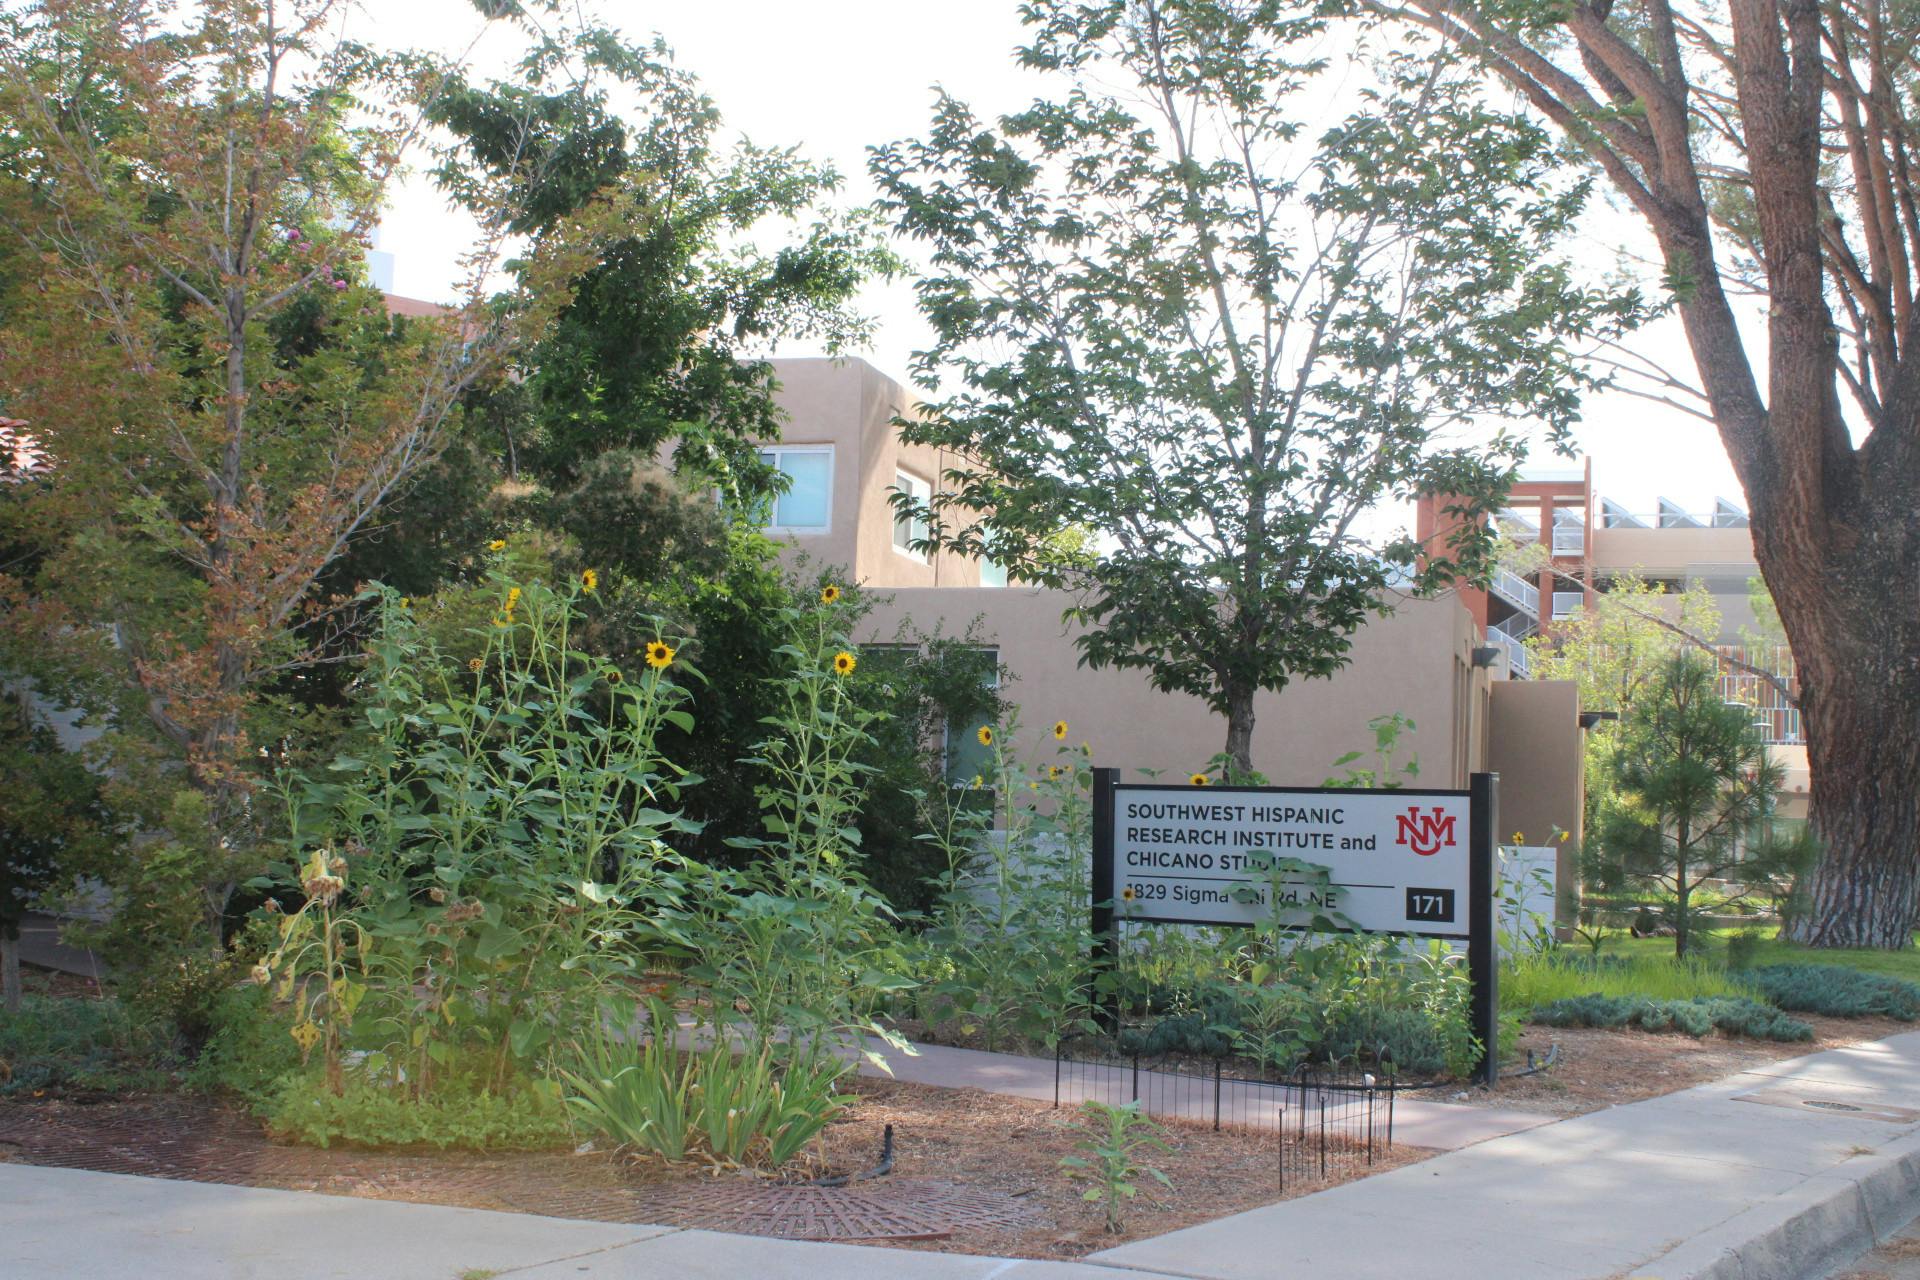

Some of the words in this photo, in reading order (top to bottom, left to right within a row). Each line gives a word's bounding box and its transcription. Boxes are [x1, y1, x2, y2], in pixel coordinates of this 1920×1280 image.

[1127, 803, 1245, 822] SOUTHWEST
[1252, 807, 1345, 824] HISPANIC
[1127, 827, 1227, 845] RESEARCH
[1233, 831, 1334, 849] INSTITUTE
[1340, 835, 1376, 850] and
[1127, 851, 1213, 870] CHICANO
[1173, 885, 1229, 905] Sigma
[1310, 891, 1337, 909] NE
[1412, 895, 1443, 915] 171
